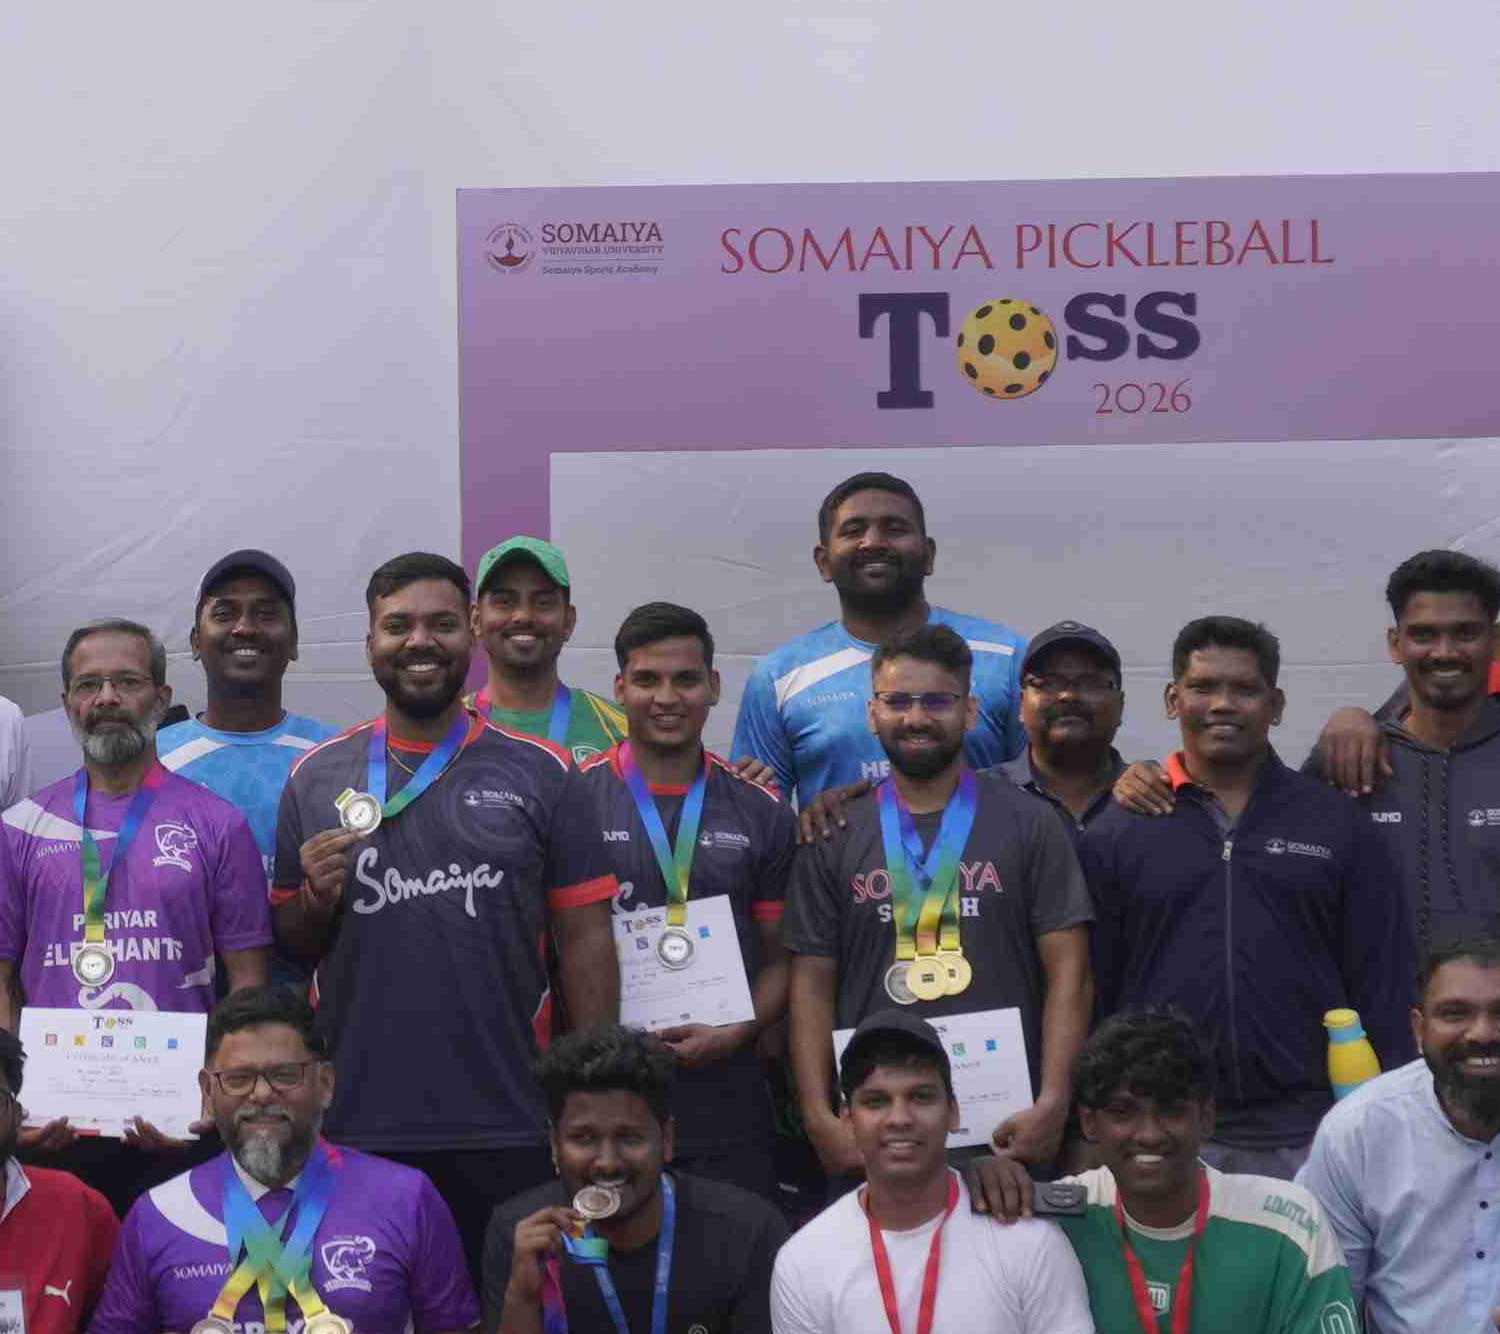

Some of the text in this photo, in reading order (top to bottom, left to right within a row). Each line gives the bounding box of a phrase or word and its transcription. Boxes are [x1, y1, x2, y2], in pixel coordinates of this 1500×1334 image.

[541, 222, 663, 244] SOMAIYA
[720, 218, 1335, 274] SOMAIYA PICKLEBALL
[1094, 378, 1193, 414] 2026
[353, 847, 504, 918] Somaiya
[852, 861, 1004, 904] SOYA
[72, 909, 158, 931] PRIYAR
[174, 1261, 232, 1280] SOMAIYA
